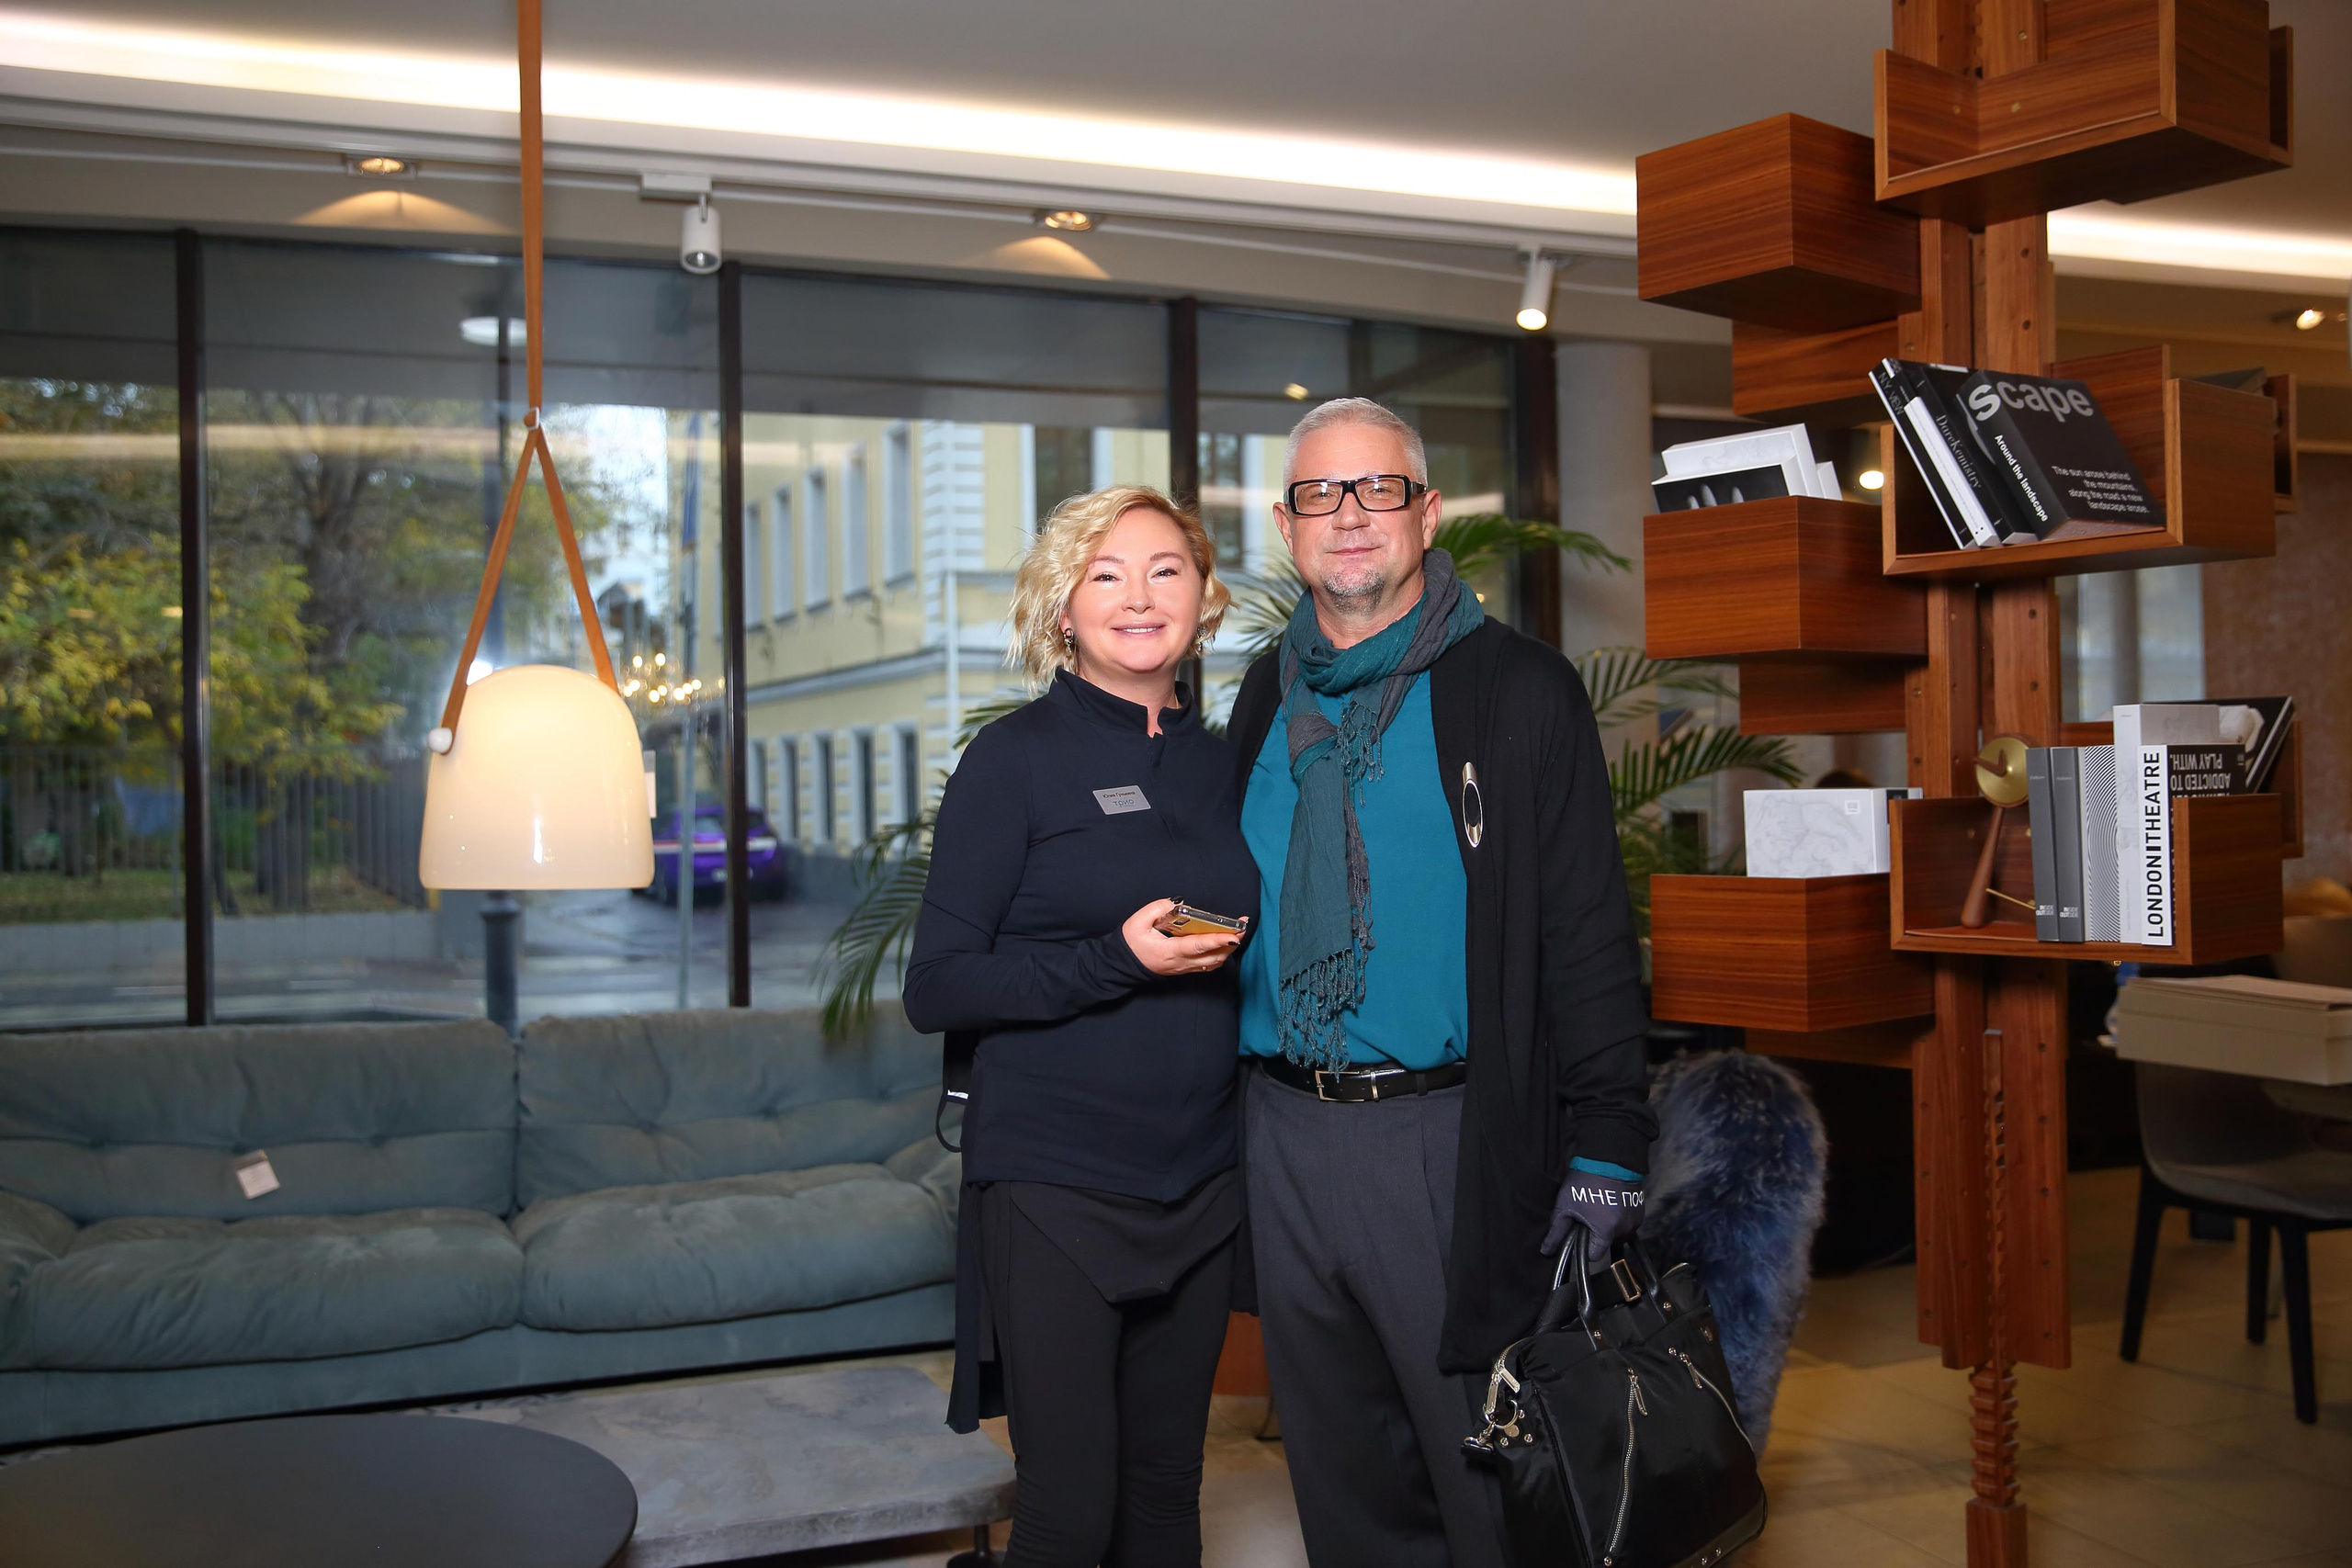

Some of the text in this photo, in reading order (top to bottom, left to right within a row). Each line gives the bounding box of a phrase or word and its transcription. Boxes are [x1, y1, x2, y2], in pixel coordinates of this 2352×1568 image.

[1995, 434, 2049, 522] Around the landscape
[2083, 479, 2097, 489] the
[2068, 489, 2091, 500] along
[2089, 490, 2103, 499] the
[2169, 753, 2199, 771] WITH.
[2199, 753, 2223, 770] PLAY
[2170, 773, 2232, 791] ADDICTED TO
[1571, 1186, 1618, 1206] МНЕ
